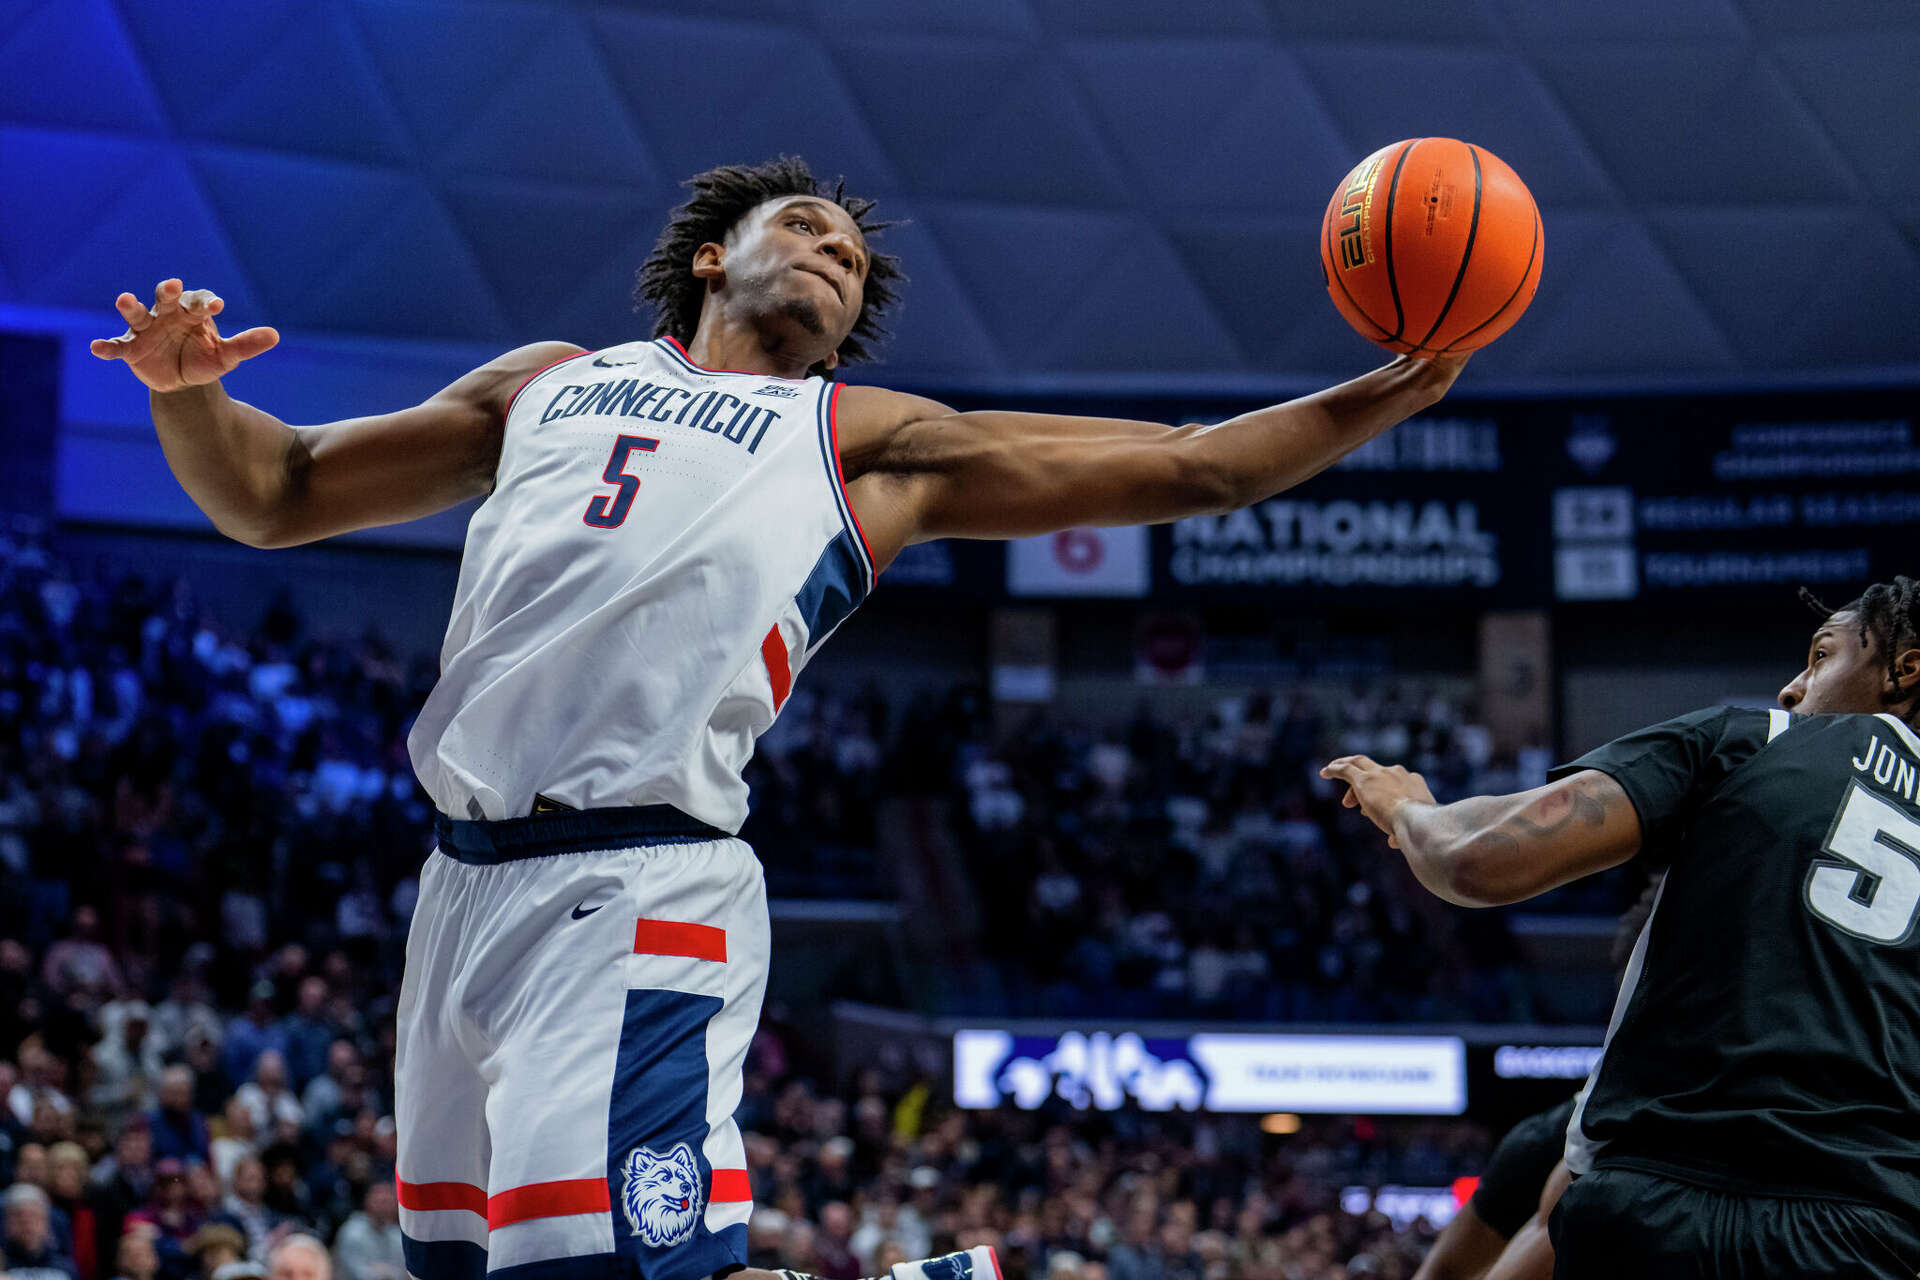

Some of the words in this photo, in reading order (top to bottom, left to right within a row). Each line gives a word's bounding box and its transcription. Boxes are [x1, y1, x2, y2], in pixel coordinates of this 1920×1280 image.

[1340, 160, 1377, 271] ELITE
[540, 379, 782, 455] CONNECTICUT
[756, 389, 803, 398] EAST
[763, 384, 798, 392] BIG
[583, 434, 660, 529] 5
[1173, 500, 1497, 549] NATIONAL
[1170, 548, 1500, 587] CHAMPIONSHIPS
[1852, 735, 1920, 807] JON
[1803, 776, 1920, 946] 5
